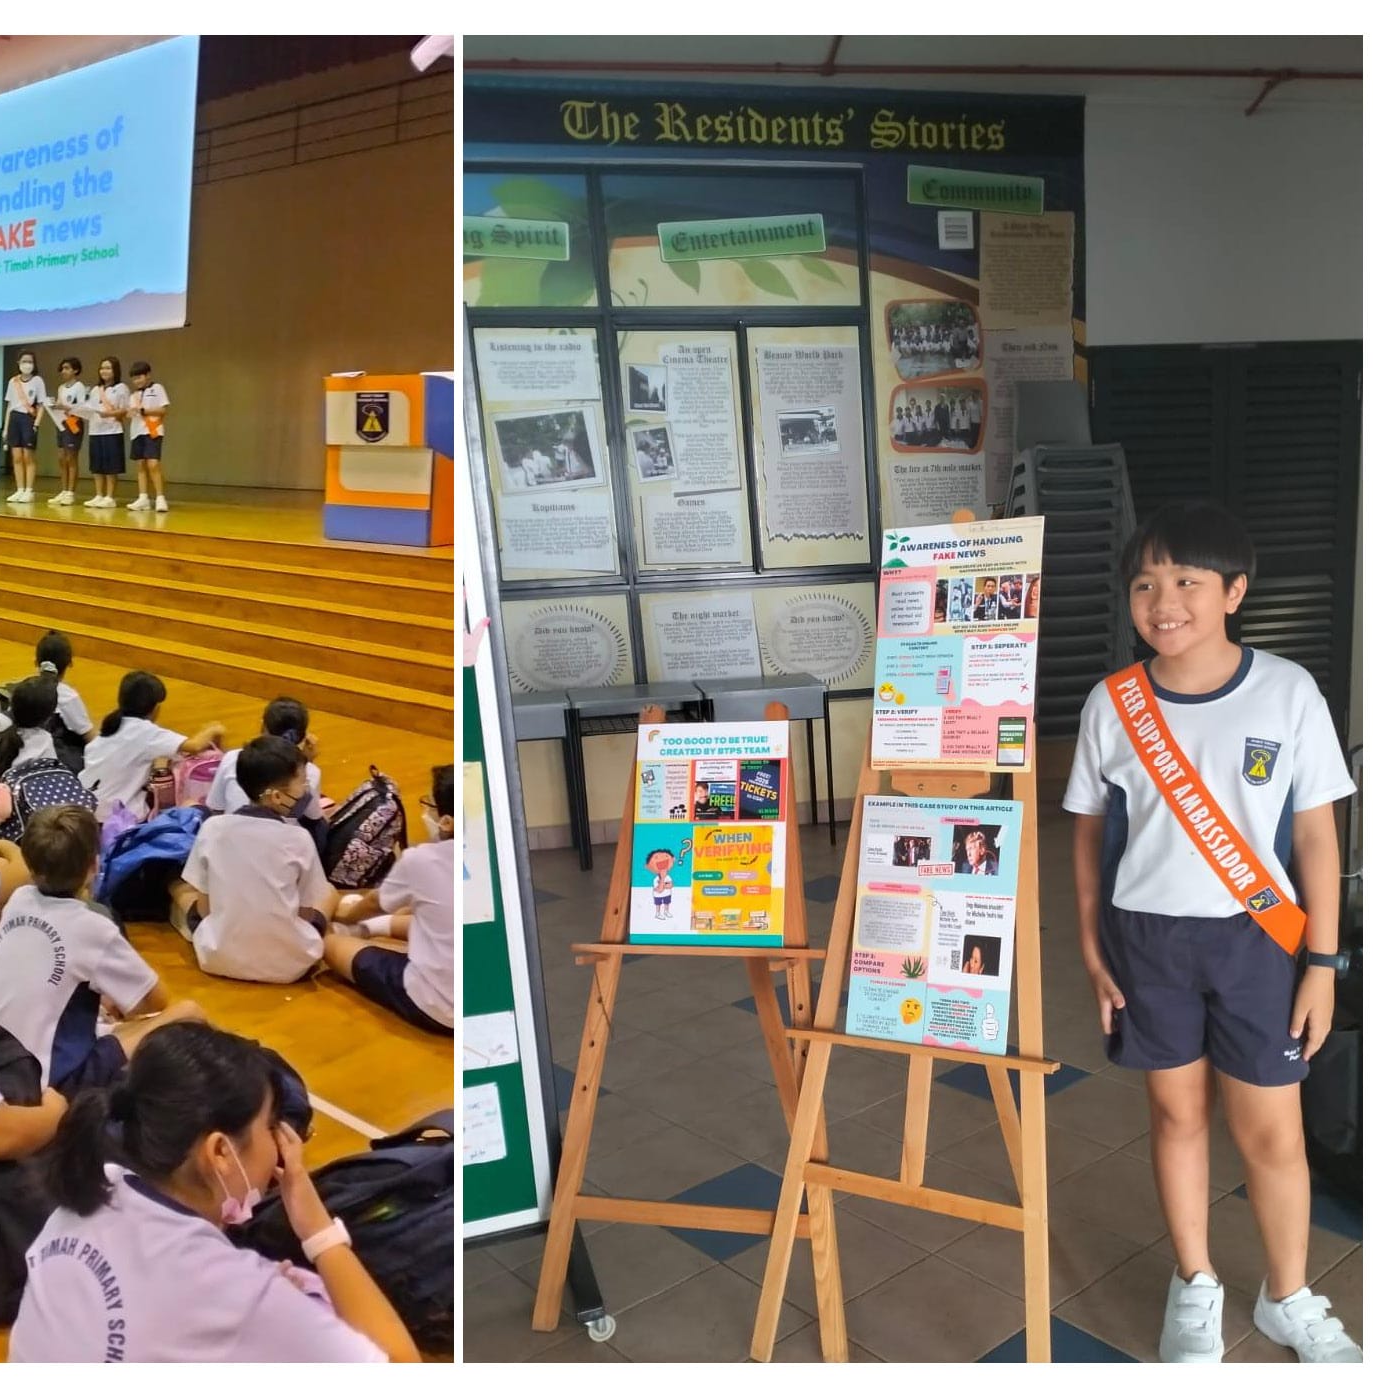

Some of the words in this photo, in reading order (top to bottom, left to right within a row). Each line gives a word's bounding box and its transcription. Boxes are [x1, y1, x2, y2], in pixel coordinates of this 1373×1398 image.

[96, 115, 124, 150] of
[560, 100, 640, 146] The
[654, 102, 855, 146] Residents'
[870, 108, 1006, 150] Stories
[72, 166, 113, 198] the
[922, 177, 1033, 201] Community
[42, 214, 102, 244] news
[491, 224, 560, 248] Spirit
[671, 218, 815, 253] Entertainment
[3, 256, 34, 272] Timah
[37, 253, 77, 267] Primary
[81, 243, 120, 262] School
[900, 540, 958, 552] AWARENESS
[959, 539, 972, 548] OF
[972, 535, 1023, 547] HANDLING
[933, 552, 956, 561] FAKE
[957, 549, 987, 558] NEWS
[660, 748, 702, 756] CREATED
[704, 748, 717, 756] BY
[717, 747, 742, 755] BTPS
[740, 781, 778, 801] TICKETS
[1117, 677, 1147, 717] PEER
[1133, 712, 1186, 785] SUPPORT
[1172, 783, 1257, 891] AMBASSADOR
[694, 843, 772, 859] VERIFYING
[714, 832, 752, 844] WHEN
[2, 916, 26, 934] TIMAH
[27, 916, 62, 944] PRIMARY
[47, 945, 66, 986] SCHOOL
[854, 959, 885, 967] COMPARE
[78, 1243, 124, 1311] PRIMARY
[104, 1318, 126, 1363] SCH
